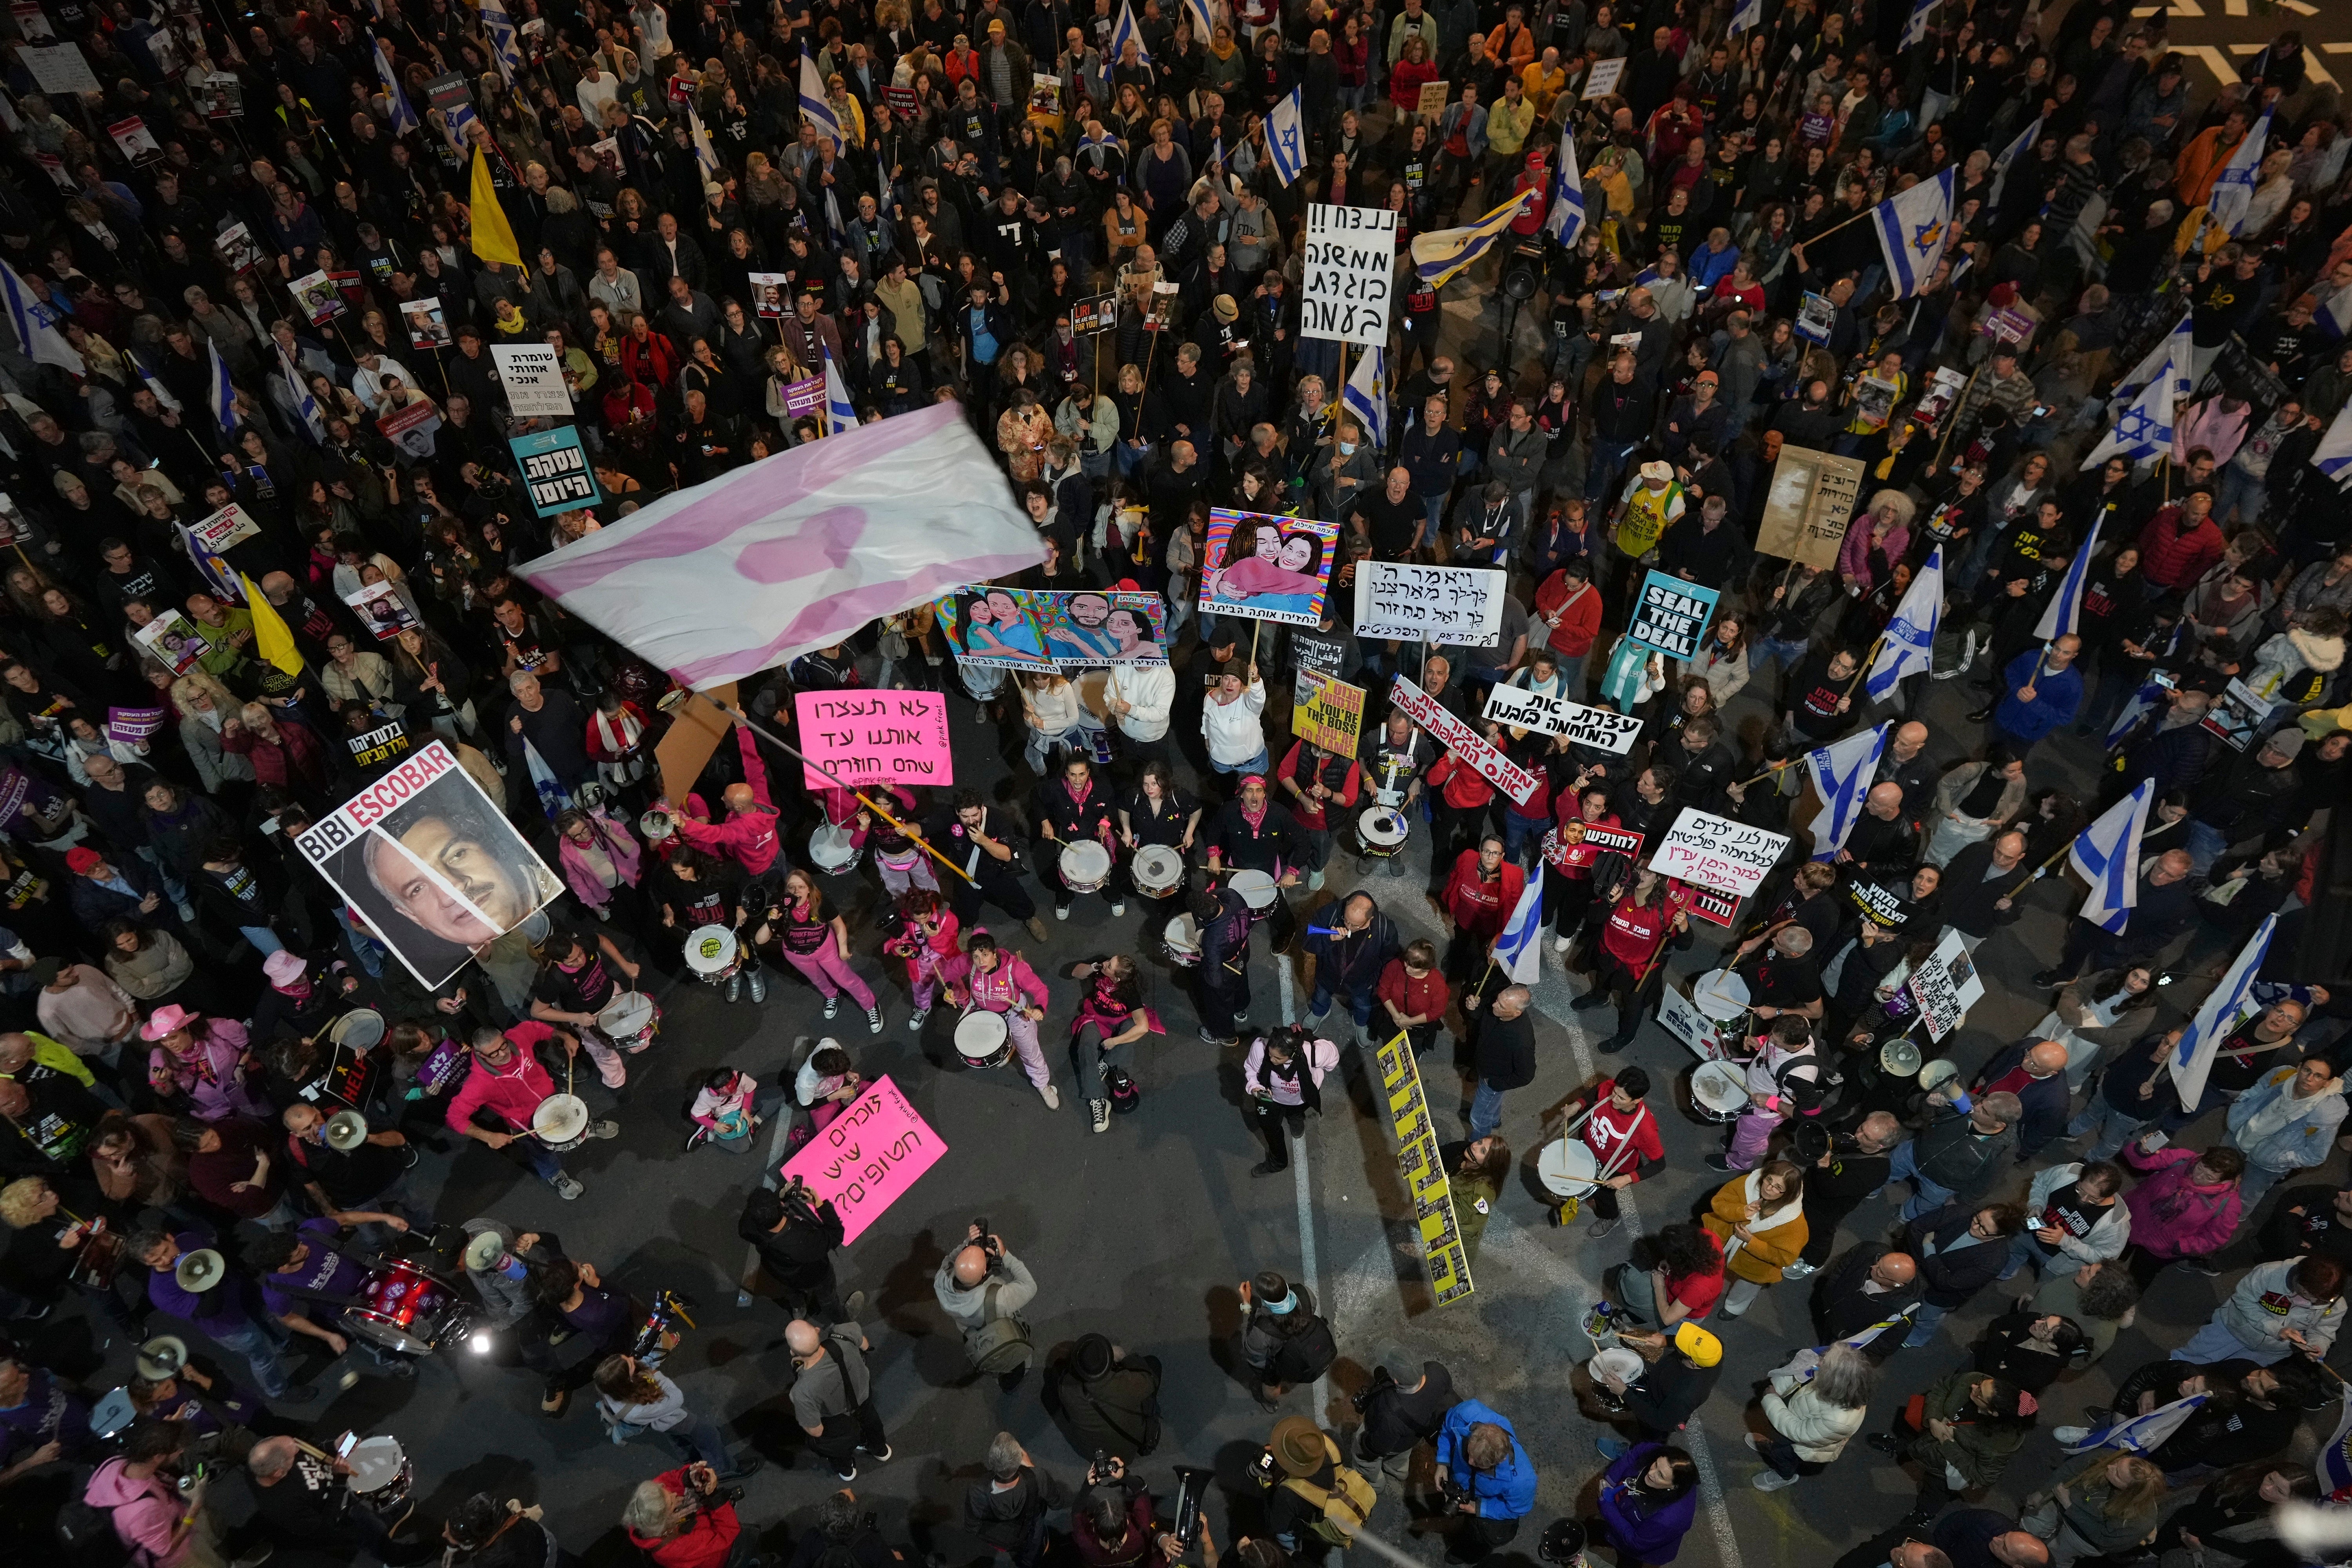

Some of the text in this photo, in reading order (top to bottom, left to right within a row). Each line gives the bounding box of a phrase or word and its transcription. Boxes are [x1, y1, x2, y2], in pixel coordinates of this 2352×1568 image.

[1307, 243, 1388, 272] ממשלה
[1309, 270, 1387, 303] בוגדת
[1075, 304, 1090, 319] LIRI
[1303, 298, 1381, 336] בעמה
[1075, 319, 1098, 332] FOR YOU!
[511, 352, 554, 363] שומרת
[508, 365, 548, 373] אחותי
[509, 376, 539, 385] אנכי
[510, 391, 530, 400] את
[813, 391, 826, 400] צאת
[513, 402, 563, 412] המלחמה
[533, 475, 592, 506] היום!
[1822, 471, 1856, 489] רוצים
[1817, 484, 1856, 503] בחירות
[225, 506, 237, 517] אין
[1831, 504, 1849, 515] לא
[1827, 519, 1845, 530] בתי
[1647, 586, 1704, 619] SEAL
[1249, 608, 1318, 625] החזירו אותה
[1649, 607, 1693, 633] THE
[1299, 636, 1332, 654] למלחמה
[1633, 625, 1690, 656] DEAL
[1000, 660, 1058, 672] החזירו אותה
[1303, 655, 1323, 665] STOP
[1334, 683, 1361, 702] הבוס
[1392, 684, 1428, 720] בעזה?
[815, 699, 929, 718] לא תעצרו
[1319, 702, 1358, 724] YOU'RE
[1526, 695, 1638, 733] עצרת את
[1307, 707, 1356, 735] THE BOSS
[1488, 701, 1618, 747] המלחמה בלבנון
[347, 722, 403, 754] בלעדיהם
[386, 735, 409, 753] הלך
[820, 728, 922, 747] אותנו עד
[1301, 726, 1354, 759] TO BLAME!
[1317, 723, 1355, 745] YOU'RE
[1416, 693, 1533, 789] מתי תעצור את
[1426, 719, 1480, 765] החטופות
[822, 757, 933, 775] שהם חוזרים
[299, 742, 453, 862] BIBI ESCOBAR
[1585, 829, 1638, 849] לחופש
[1692, 818, 1786, 853] אין לנו ילדים
[1668, 830, 1774, 867] למלחמה פוליטית
[1670, 846, 1761, 880] למה עדיין
[1699, 870, 1740, 890] בעזה
[1850, 880, 1873, 904] הורג
[1869, 882, 1900, 907] הלחץ
[1700, 895, 1732, 918] נולדו
[1873, 902, 1908, 924] הצבאי
[1611, 915, 1650, 936] מאבק הנשים
[1871, 913, 1895, 926] עסקה
[1928, 953, 1962, 1019] אמהות לא רוצות
[1666, 1013, 1693, 1040] BEGIN
[1924, 1010, 1937, 1034] עסקה
[1938, 1005, 1955, 1026] להיות
[428, 1051, 447, 1073] לא
[828, 1094, 882, 1147] זוכרים
[823, 1142, 862, 1180] שיש
[834, 1130, 922, 1214] חטופים?
